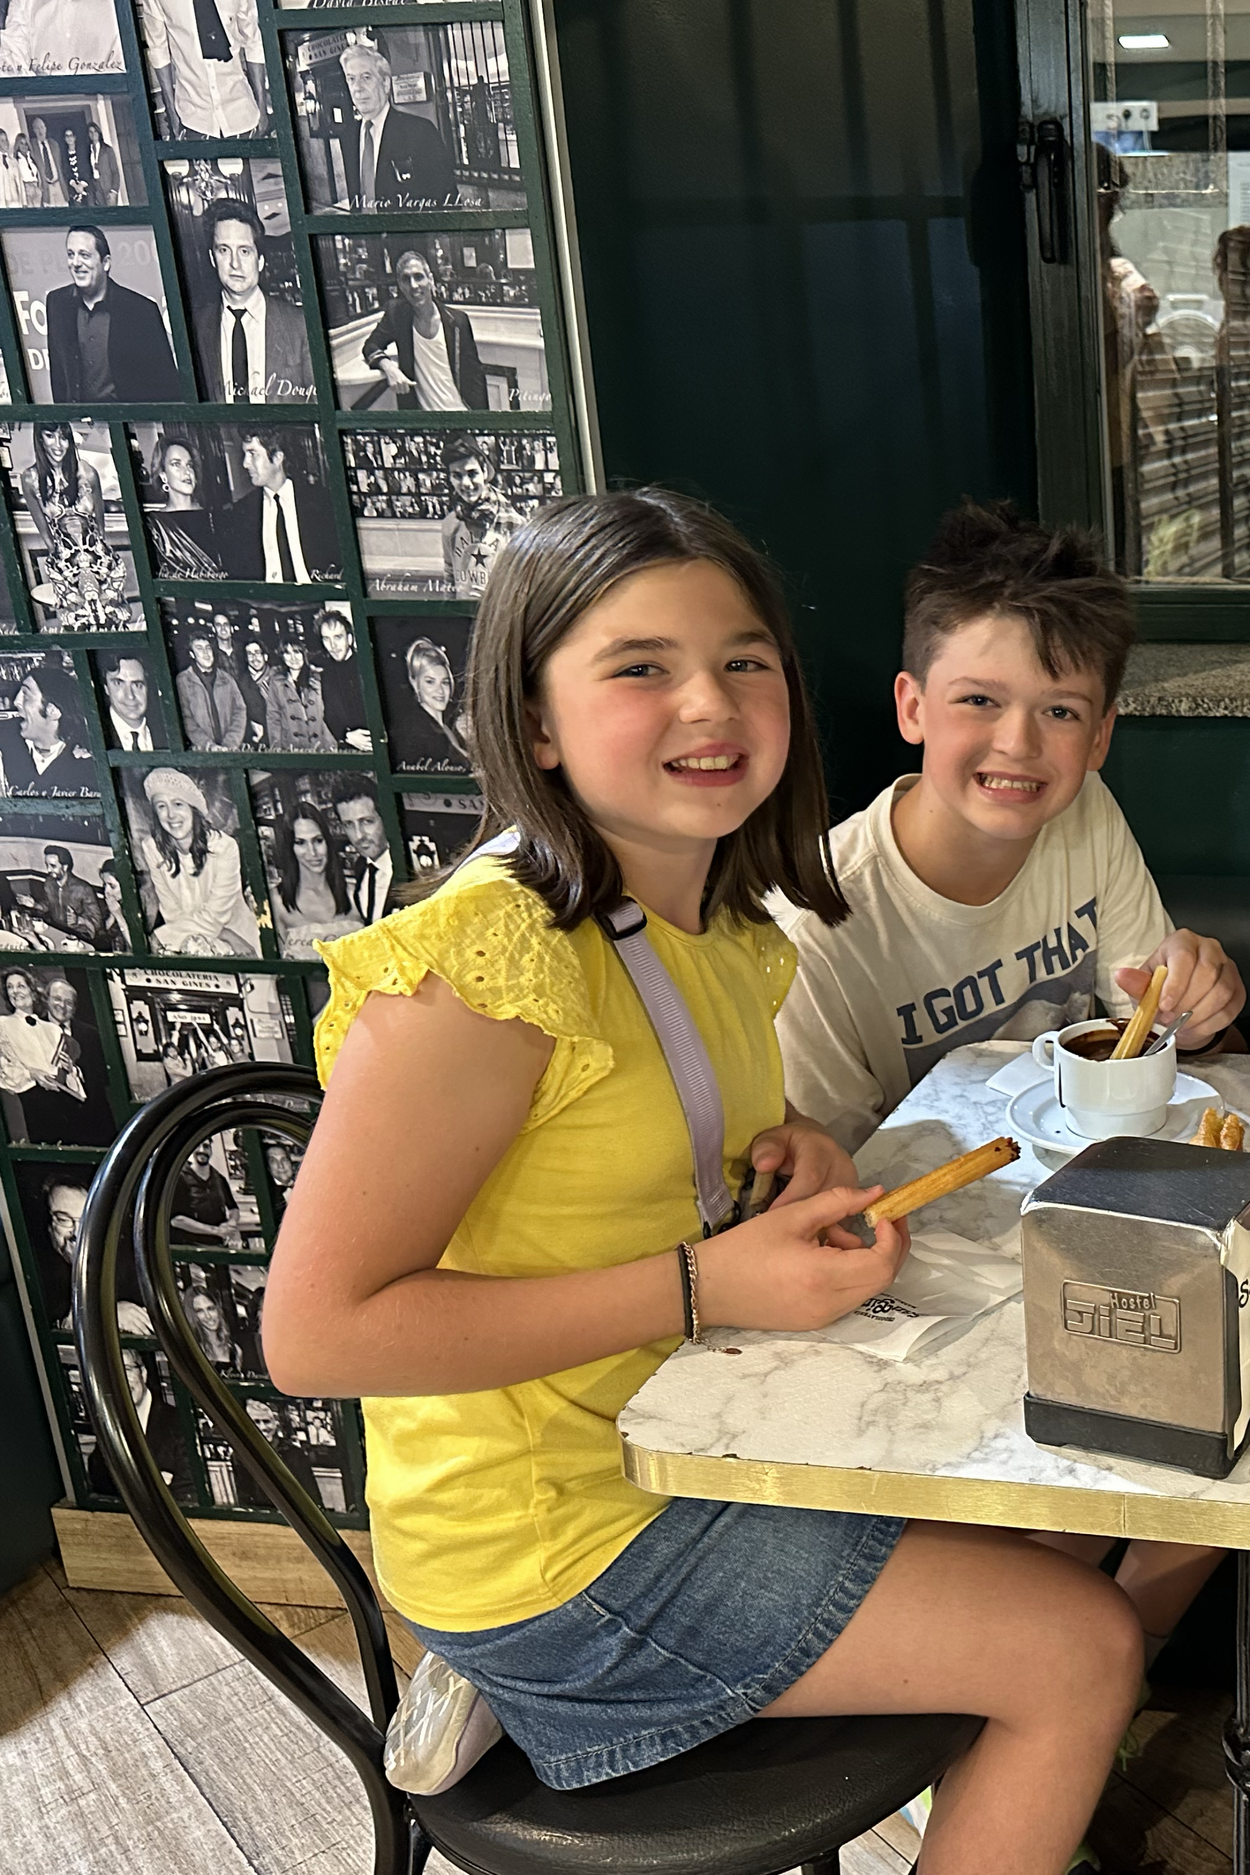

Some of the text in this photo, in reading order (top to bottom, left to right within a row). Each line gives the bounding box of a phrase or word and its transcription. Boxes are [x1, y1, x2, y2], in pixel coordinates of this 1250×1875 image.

[350, 194, 391, 209] Mario
[397, 193, 437, 211] Vargas
[368, 573, 418, 592] Abraham
[8, 781, 39, 797] Carlos
[896, 896, 1097, 1045] I GOT THAT
[1109, 1292, 1156, 1309] Hostel
